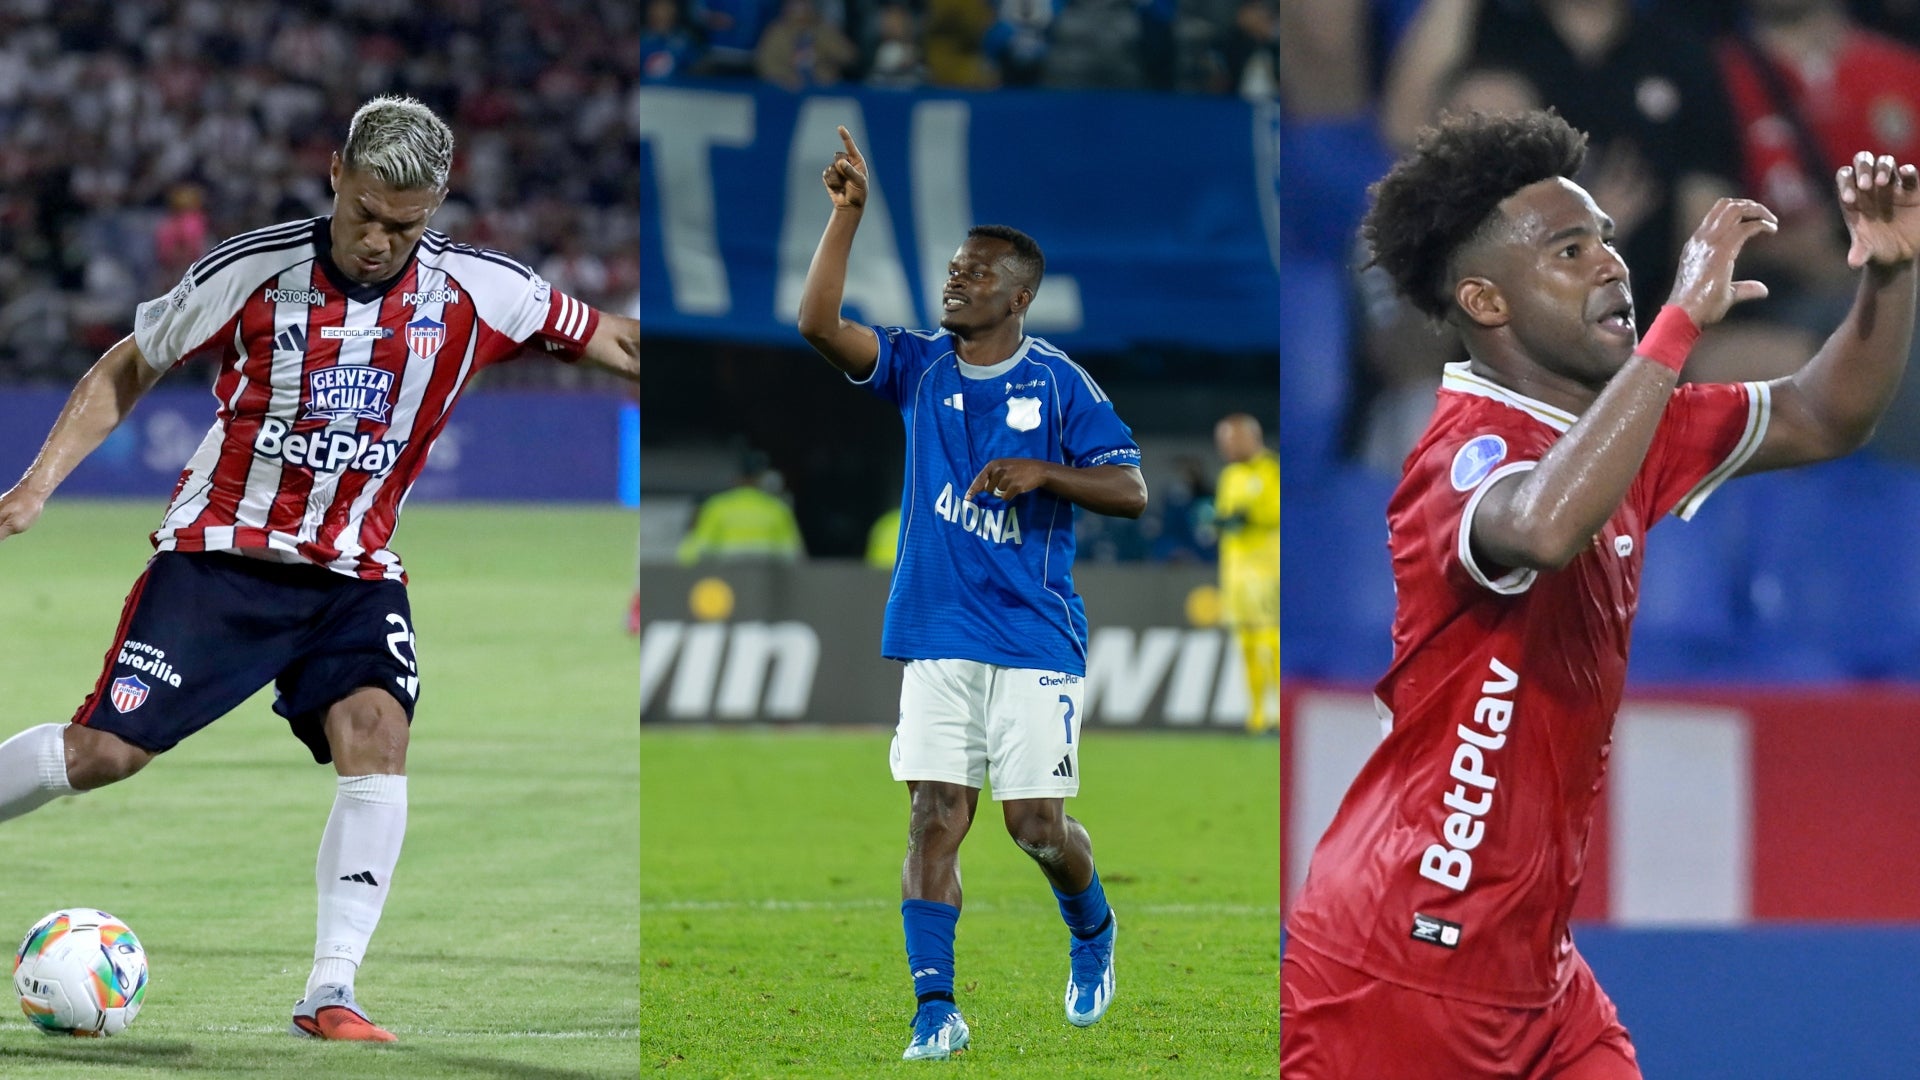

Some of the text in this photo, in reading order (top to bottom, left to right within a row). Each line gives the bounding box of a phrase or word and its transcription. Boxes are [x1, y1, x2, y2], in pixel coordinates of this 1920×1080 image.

[316, 388, 382, 412] AGUILA
[254, 419, 408, 475] BetPlay
[117, 648, 182, 688] brasilia
[124, 640, 165, 659] expreso
[1059, 694, 1075, 744] 7
